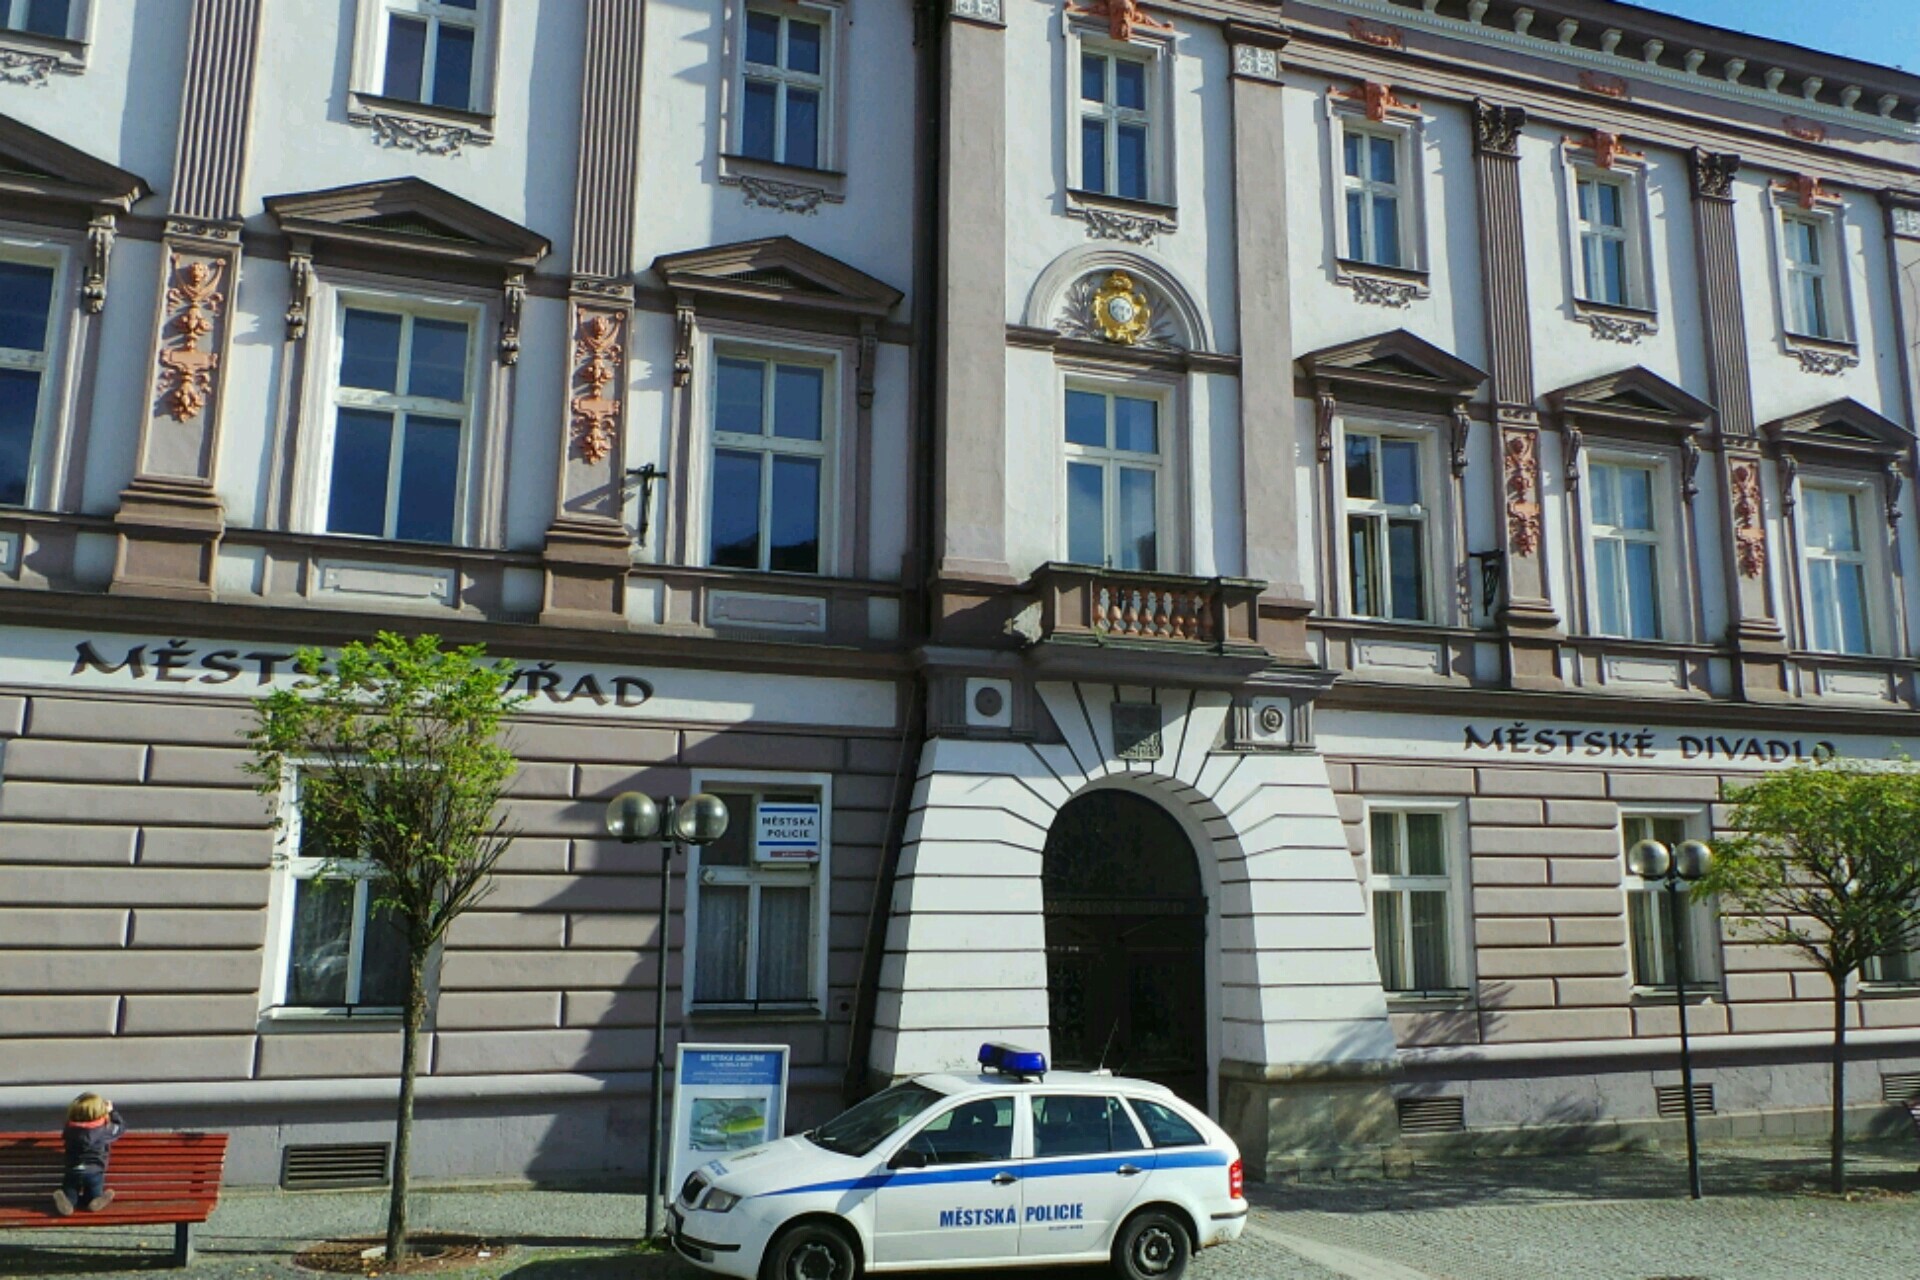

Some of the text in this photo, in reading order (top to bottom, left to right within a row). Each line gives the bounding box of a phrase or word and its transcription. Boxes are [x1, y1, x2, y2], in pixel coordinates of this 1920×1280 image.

[1463, 722, 1836, 766] MĚSTSKÉ DIVADLO
[762, 815, 815, 826] MĚSTSKÁ
[767, 829, 810, 838] POLICIE
[939, 1203, 1083, 1227] MĚSTSKÁ POLICIE
